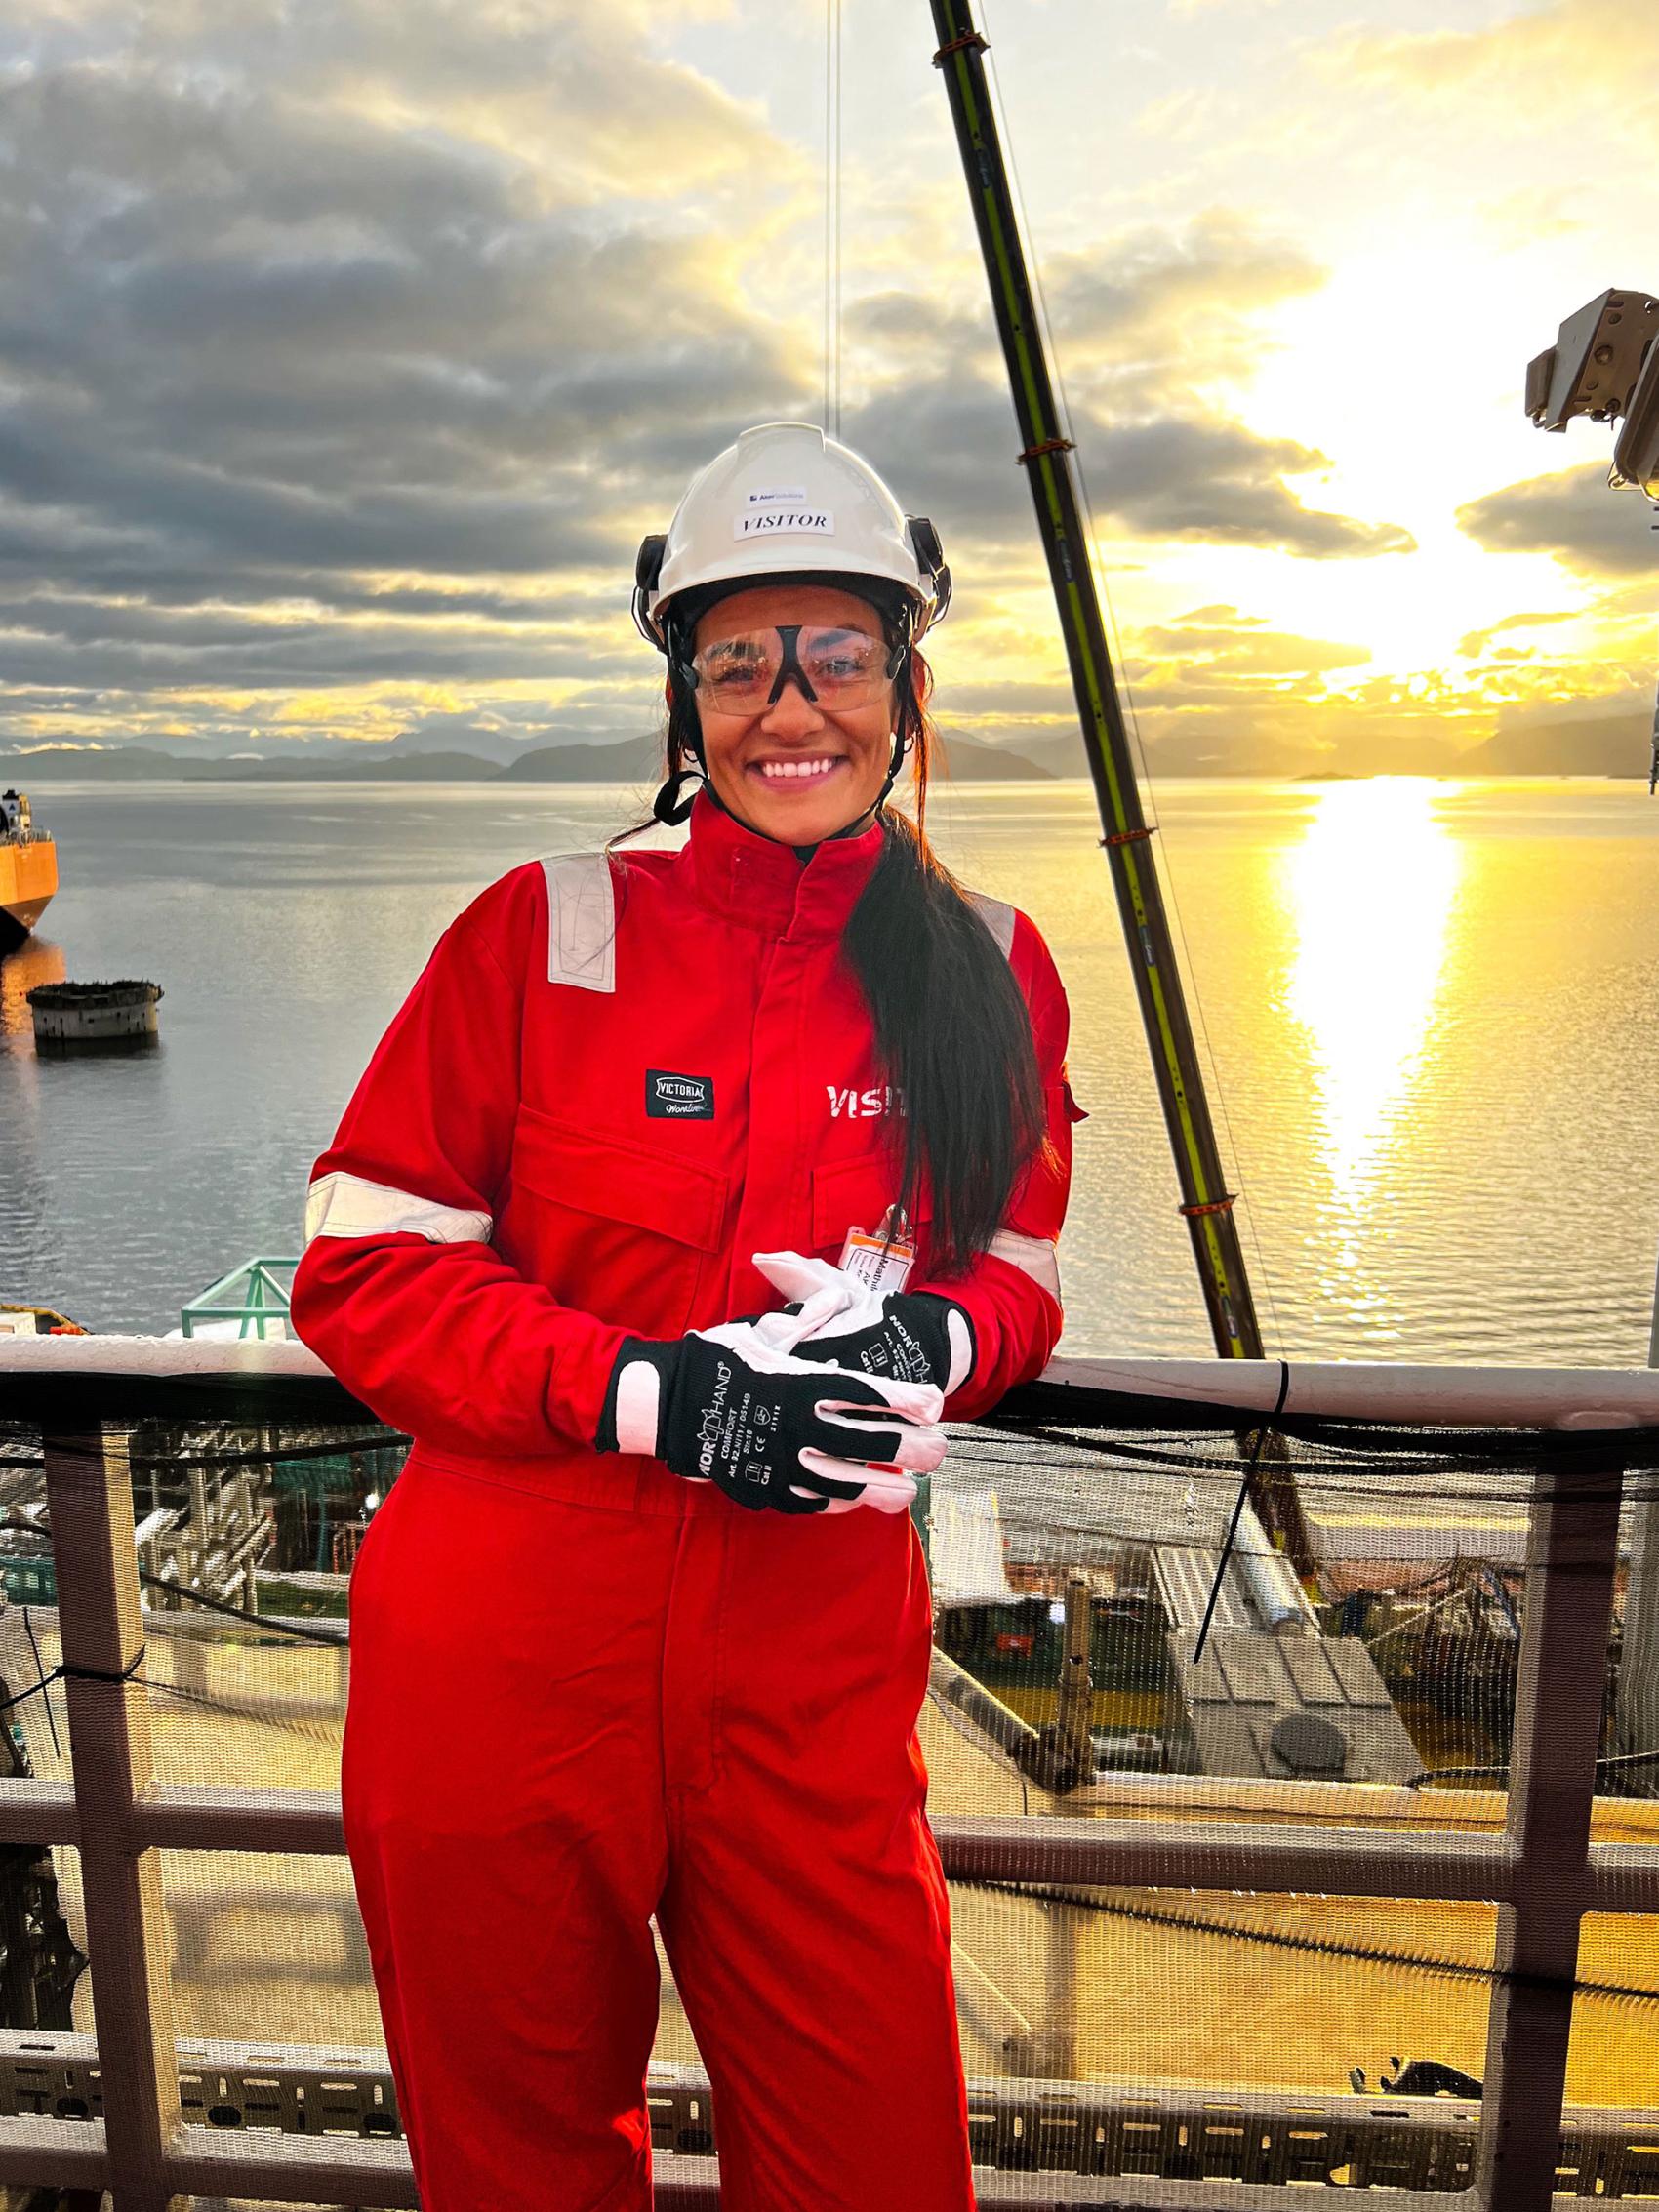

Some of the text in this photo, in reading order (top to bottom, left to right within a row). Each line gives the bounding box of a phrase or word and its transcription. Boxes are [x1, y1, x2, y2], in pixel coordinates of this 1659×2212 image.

[744, 514, 827, 531] VISITOR
[660, 1082, 702, 1097] VICTORIA
[721, 1407, 738, 1459] COMFORT
